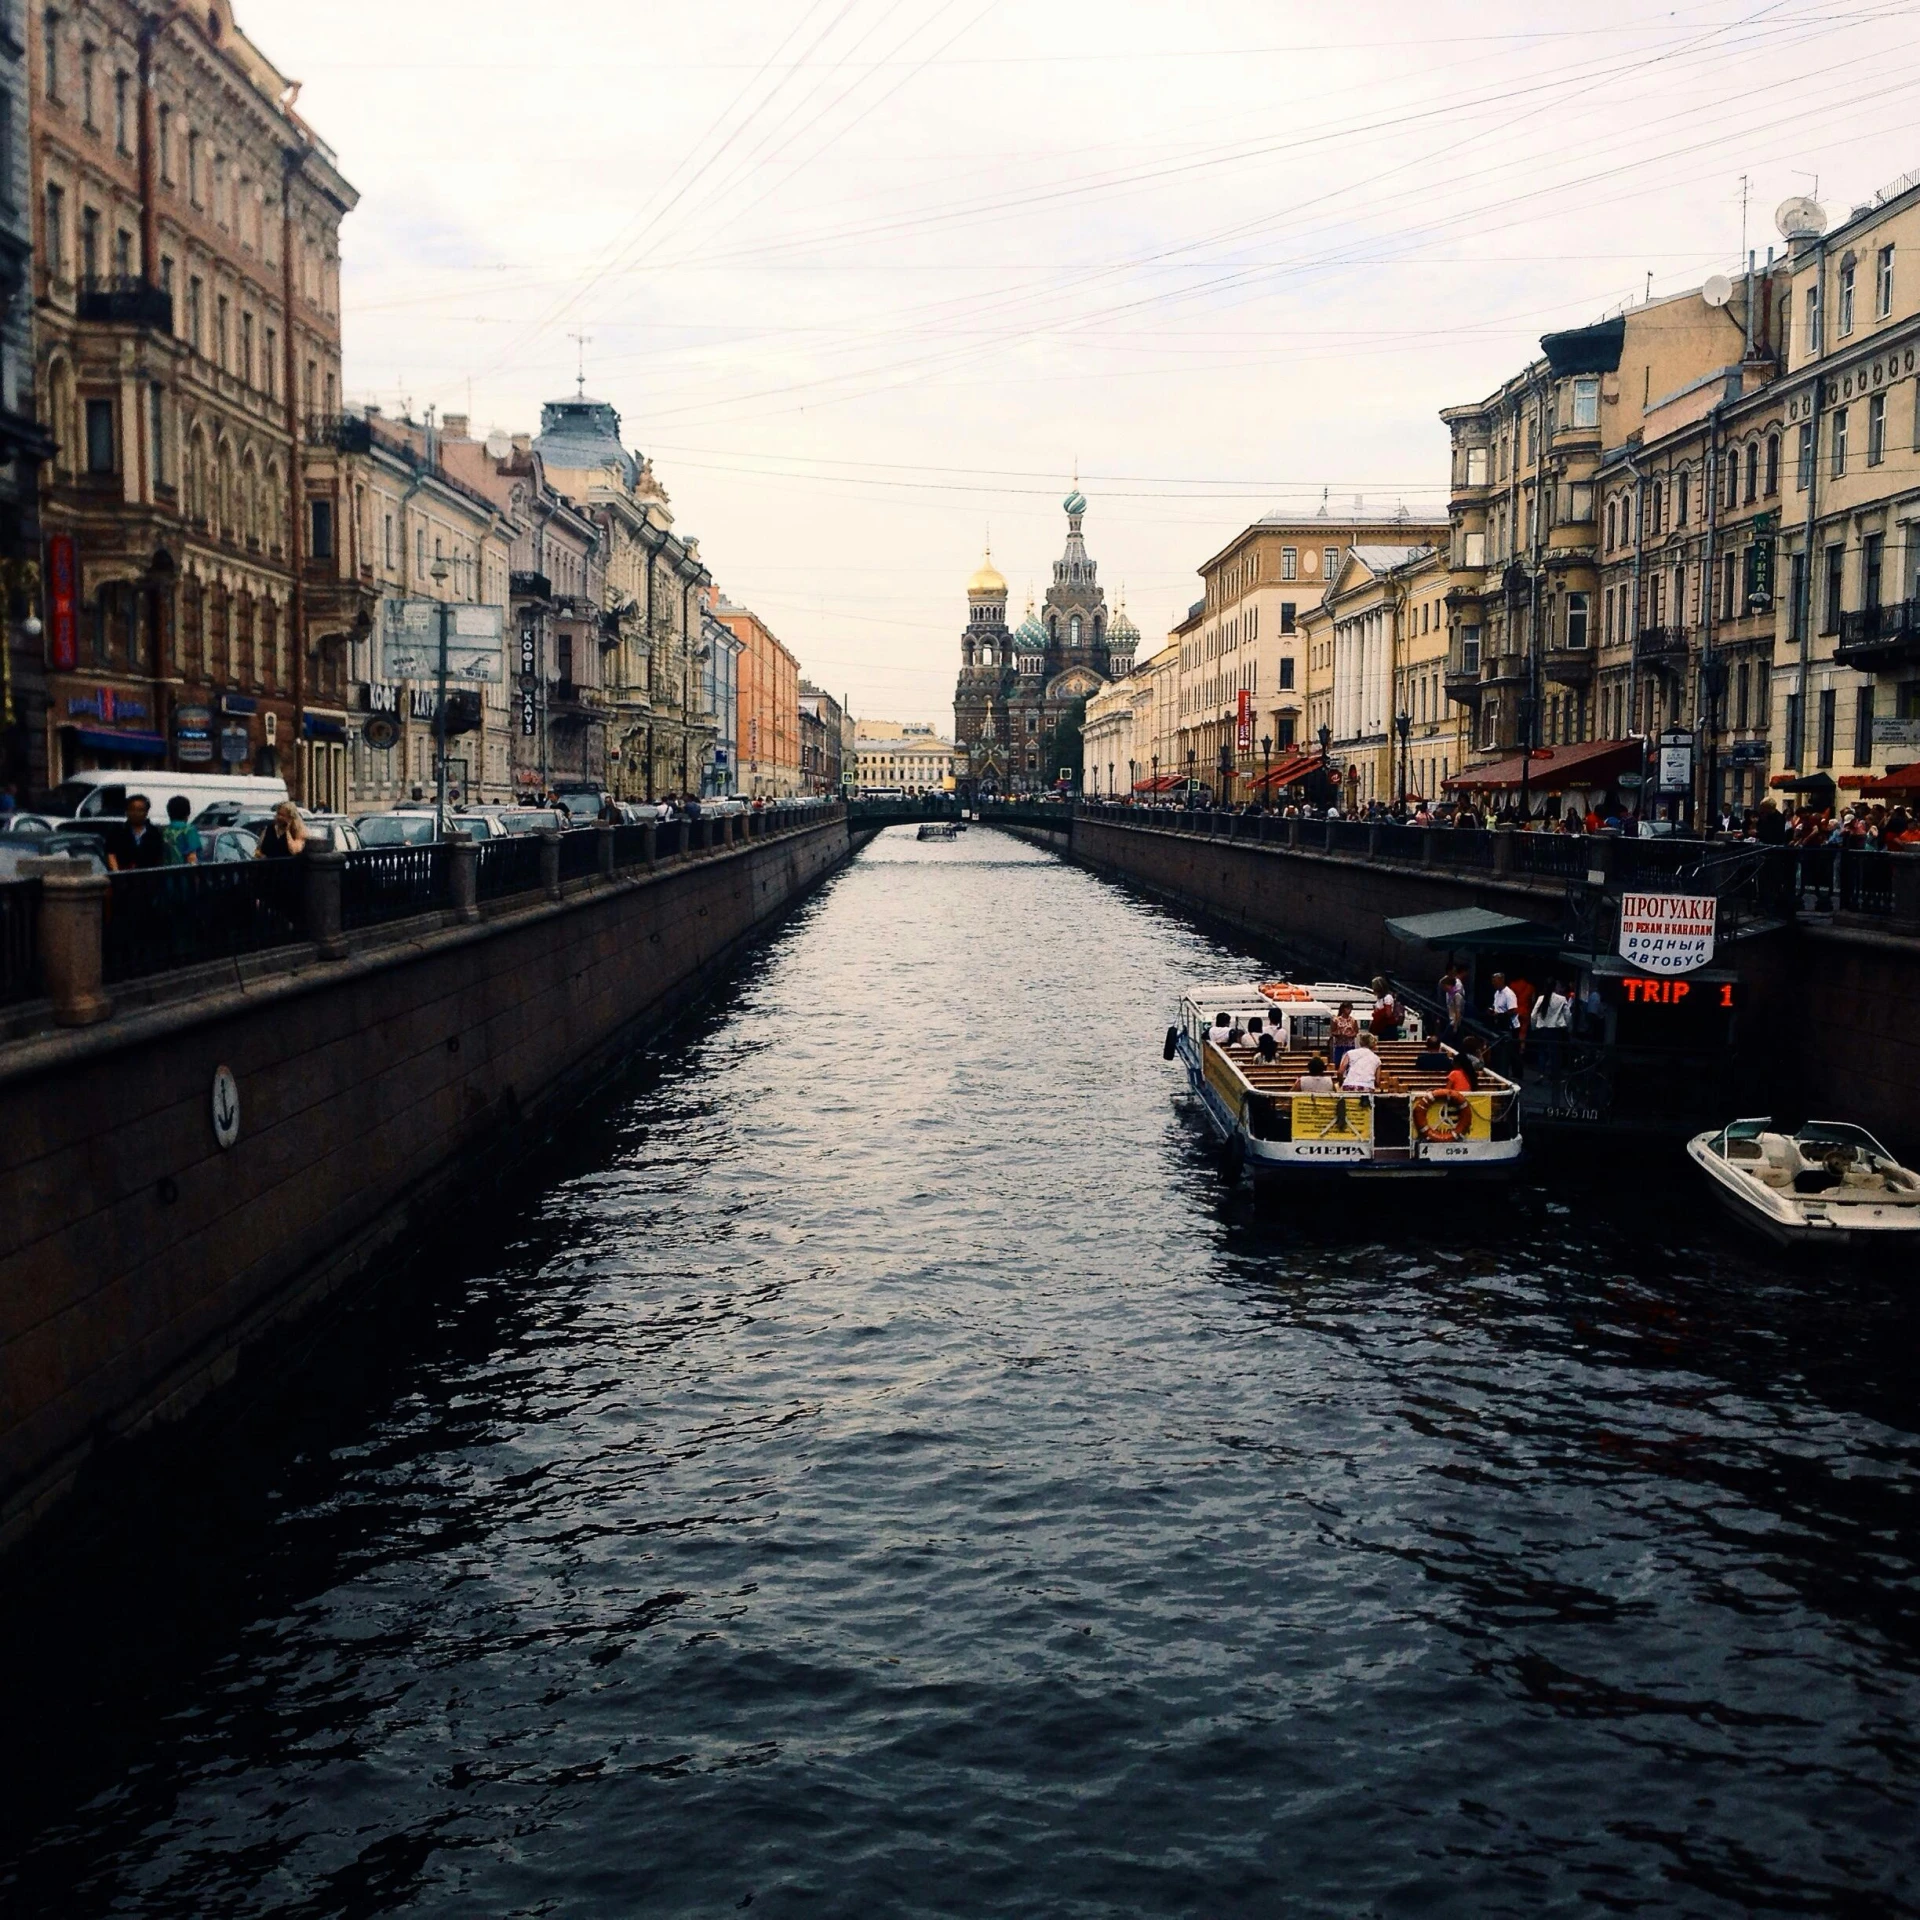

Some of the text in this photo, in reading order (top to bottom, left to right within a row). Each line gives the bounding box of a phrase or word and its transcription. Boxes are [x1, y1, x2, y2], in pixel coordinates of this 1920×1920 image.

[523, 631, 533, 672] КОФЕ
[370, 683, 396, 713] КОФЕ
[523, 694, 533, 734] ХАУЗ
[1623, 897, 1716, 921] ПРОГУЛКИ
[1623, 922, 1713, 936] ПО РЕКАМ И КАНАЛАМ
[1628, 937, 1706, 951] ВОДНЫЙ
[1628, 951, 1705, 967] АВТОБУС
[1623, 979, 1733, 1006] TRIP 1
[1295, 1145, 1365, 1156] СИЕРРА
[1422, 1147, 1429, 1156] 4
